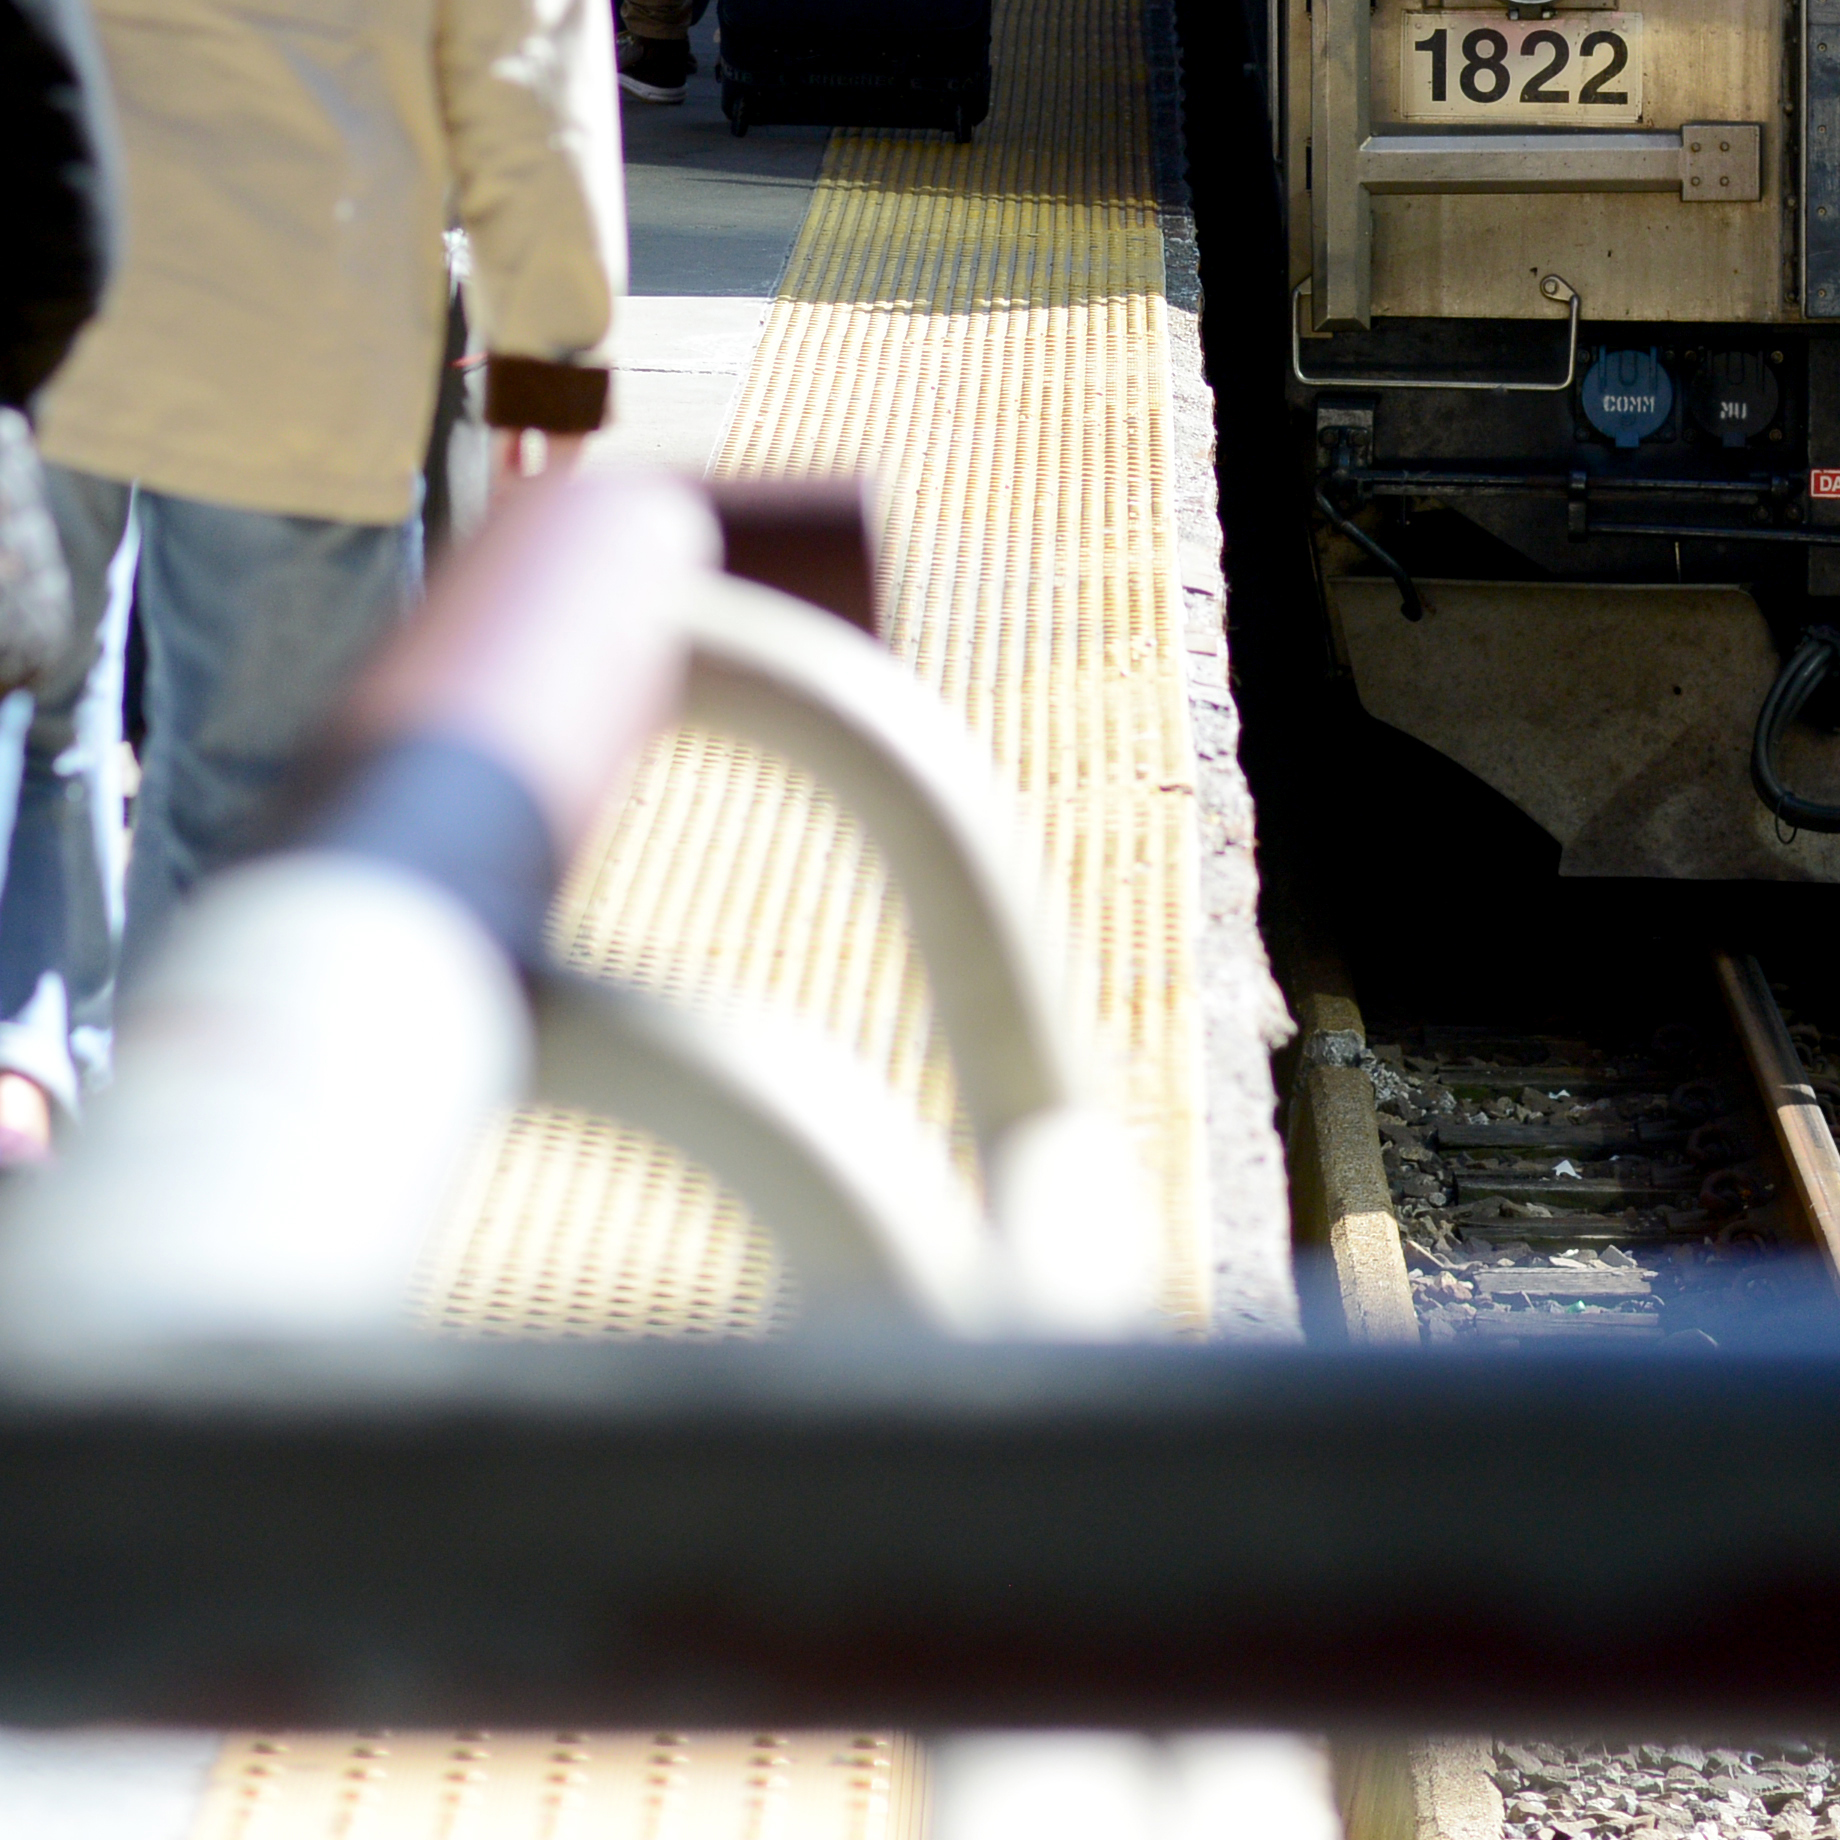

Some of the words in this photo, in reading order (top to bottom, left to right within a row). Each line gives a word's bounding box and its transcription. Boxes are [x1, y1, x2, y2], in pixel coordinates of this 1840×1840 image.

[1414, 27, 1629, 105] 1822
[1602, 394, 1656, 413] COMM
[1720, 401, 1748, 420] MU
